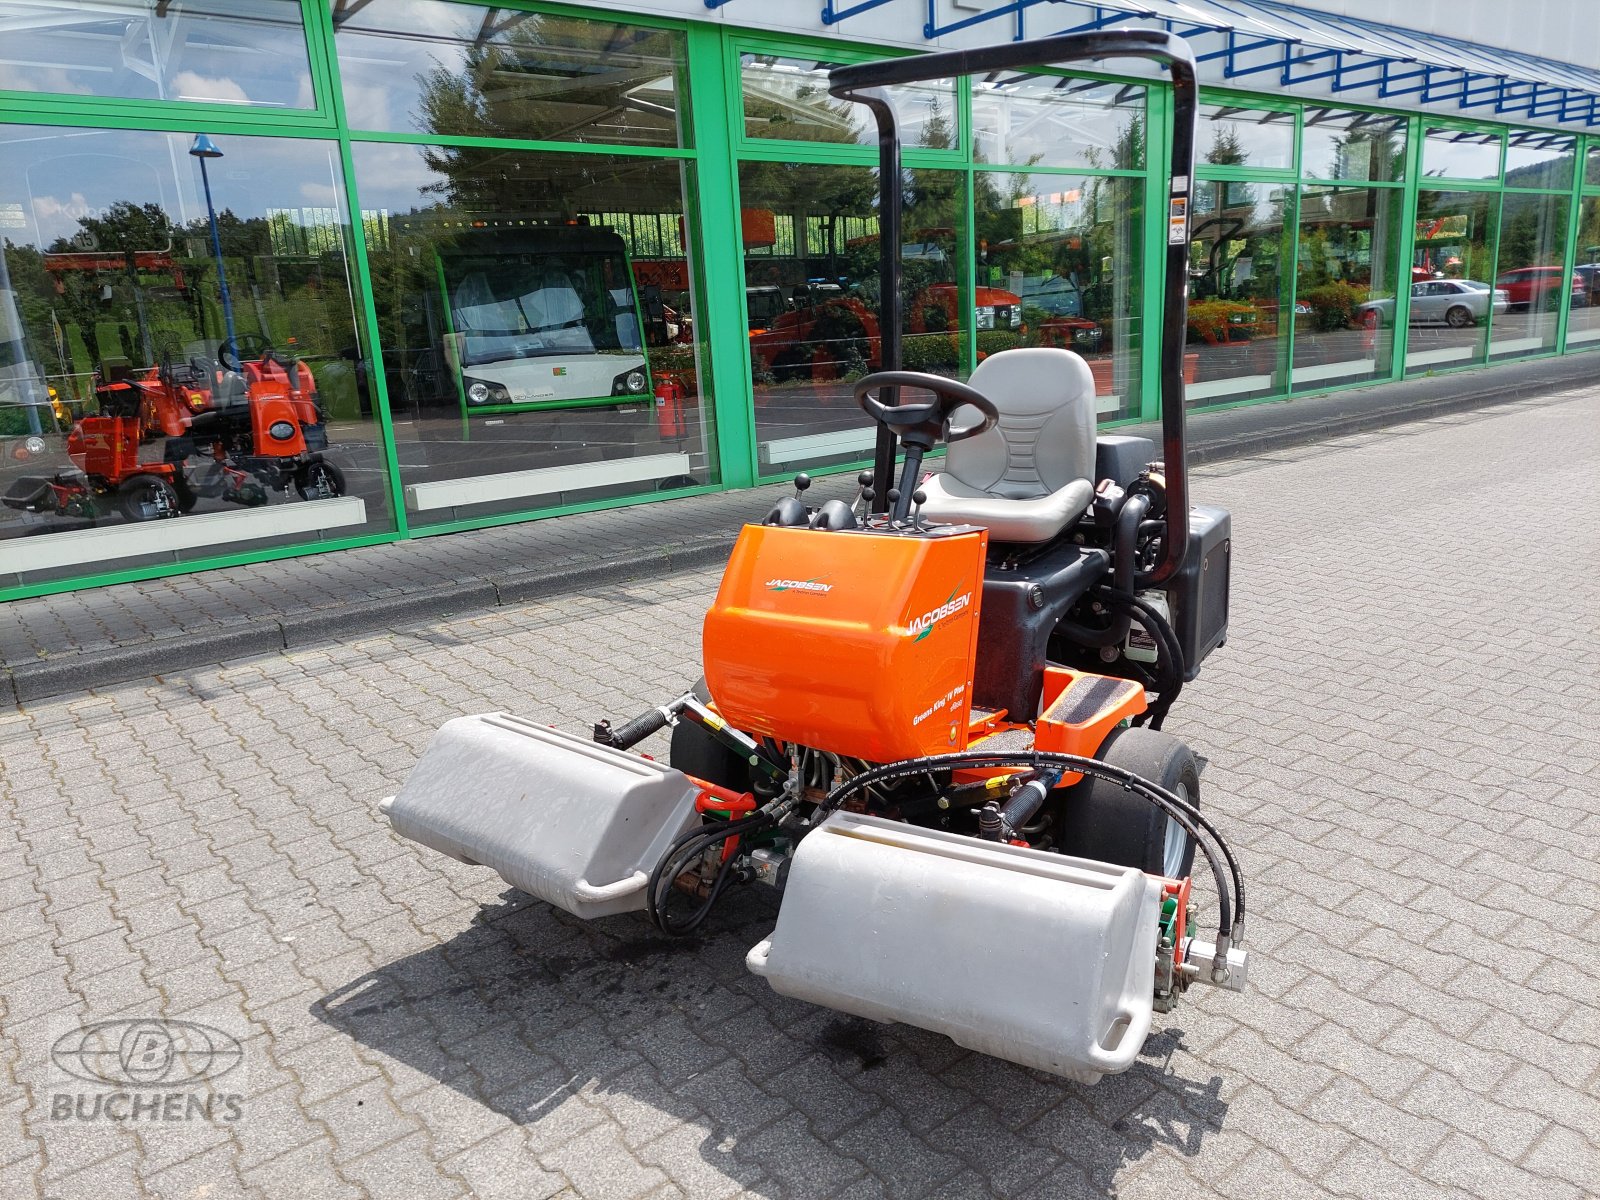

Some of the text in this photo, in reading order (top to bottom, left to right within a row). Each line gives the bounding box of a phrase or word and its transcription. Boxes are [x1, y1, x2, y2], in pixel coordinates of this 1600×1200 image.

[765, 579, 833, 592] JACOBSEN
[907, 592, 972, 636] JACOBSEN
[913, 708, 932, 726] Greens
[953, 685, 965, 697] Plus
